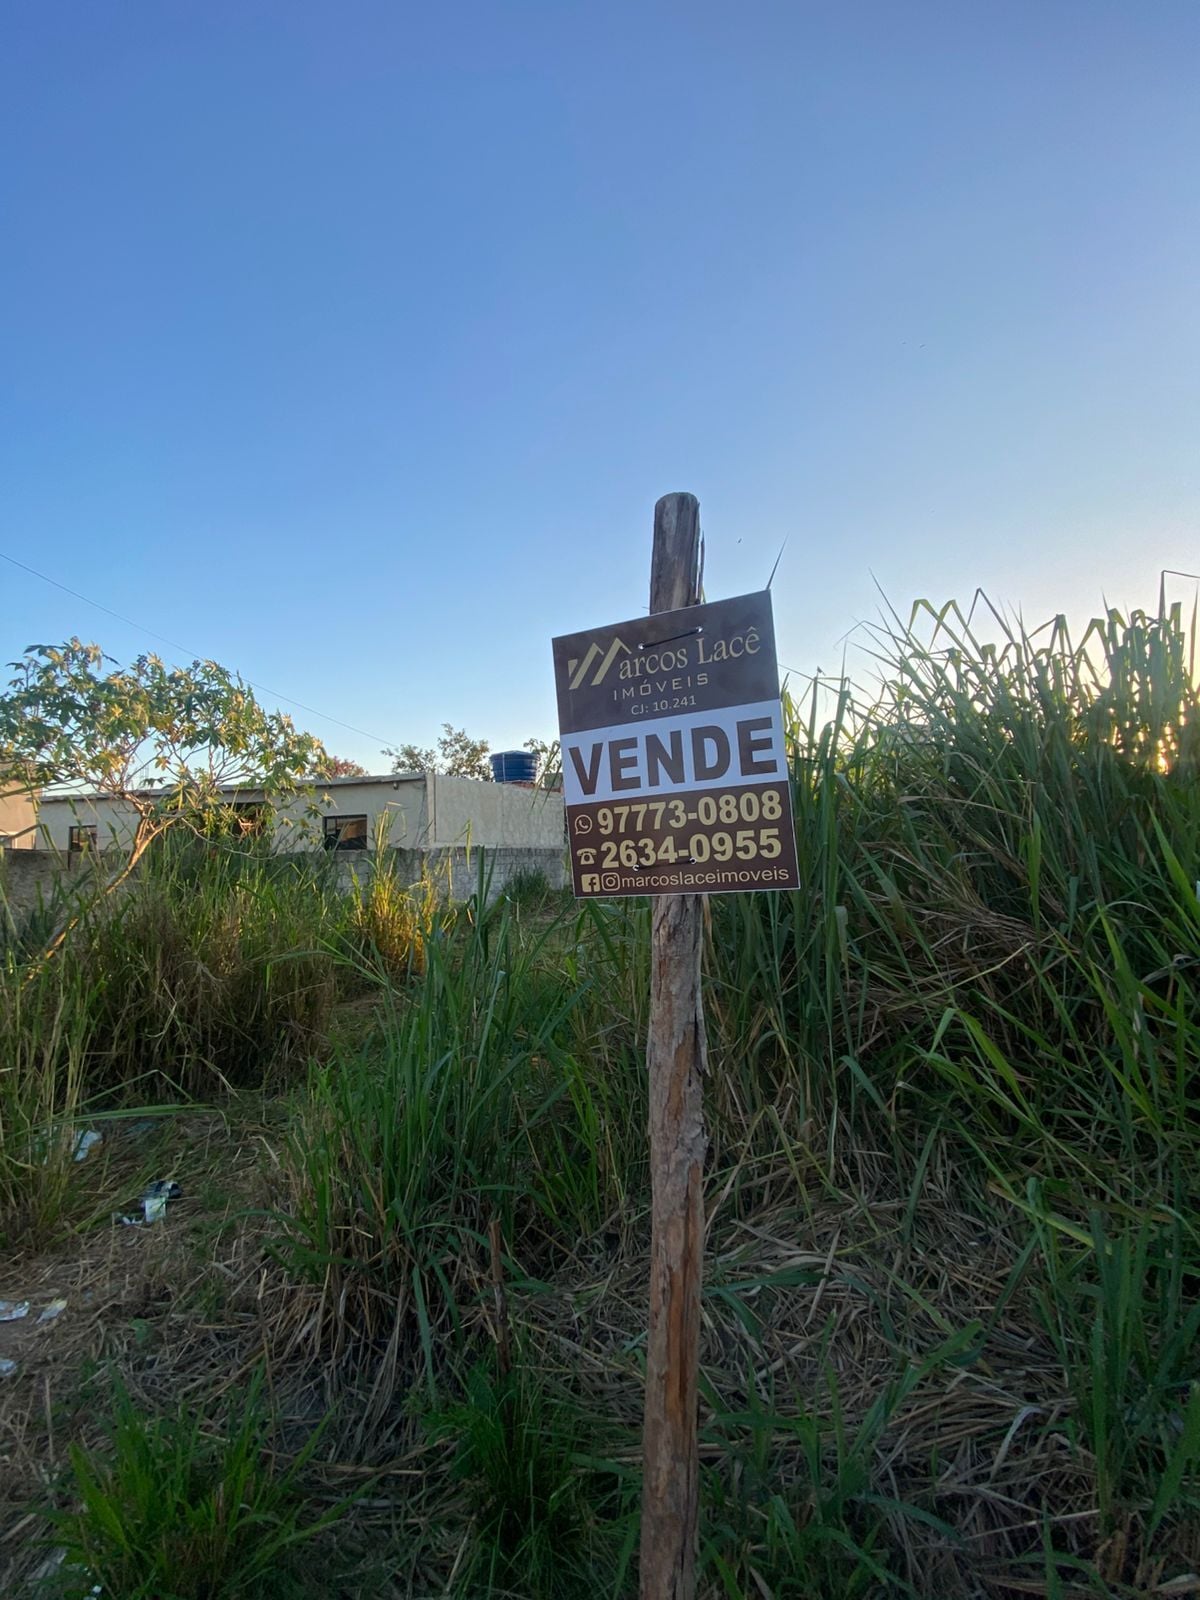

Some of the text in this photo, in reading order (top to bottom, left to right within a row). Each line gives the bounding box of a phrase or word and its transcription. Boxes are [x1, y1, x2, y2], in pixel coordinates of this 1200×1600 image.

[696, 626, 761, 665] Lacê
[613, 673, 708, 701] IMÓVEIS
[631, 695, 696, 716] CJ: 10.241
[568, 716, 778, 795] VENDE
[597, 790, 782, 835] 97773-0808
[601, 828, 782, 869] 2634-0955
[621, 866, 789, 888] marcoslaceimoveis
